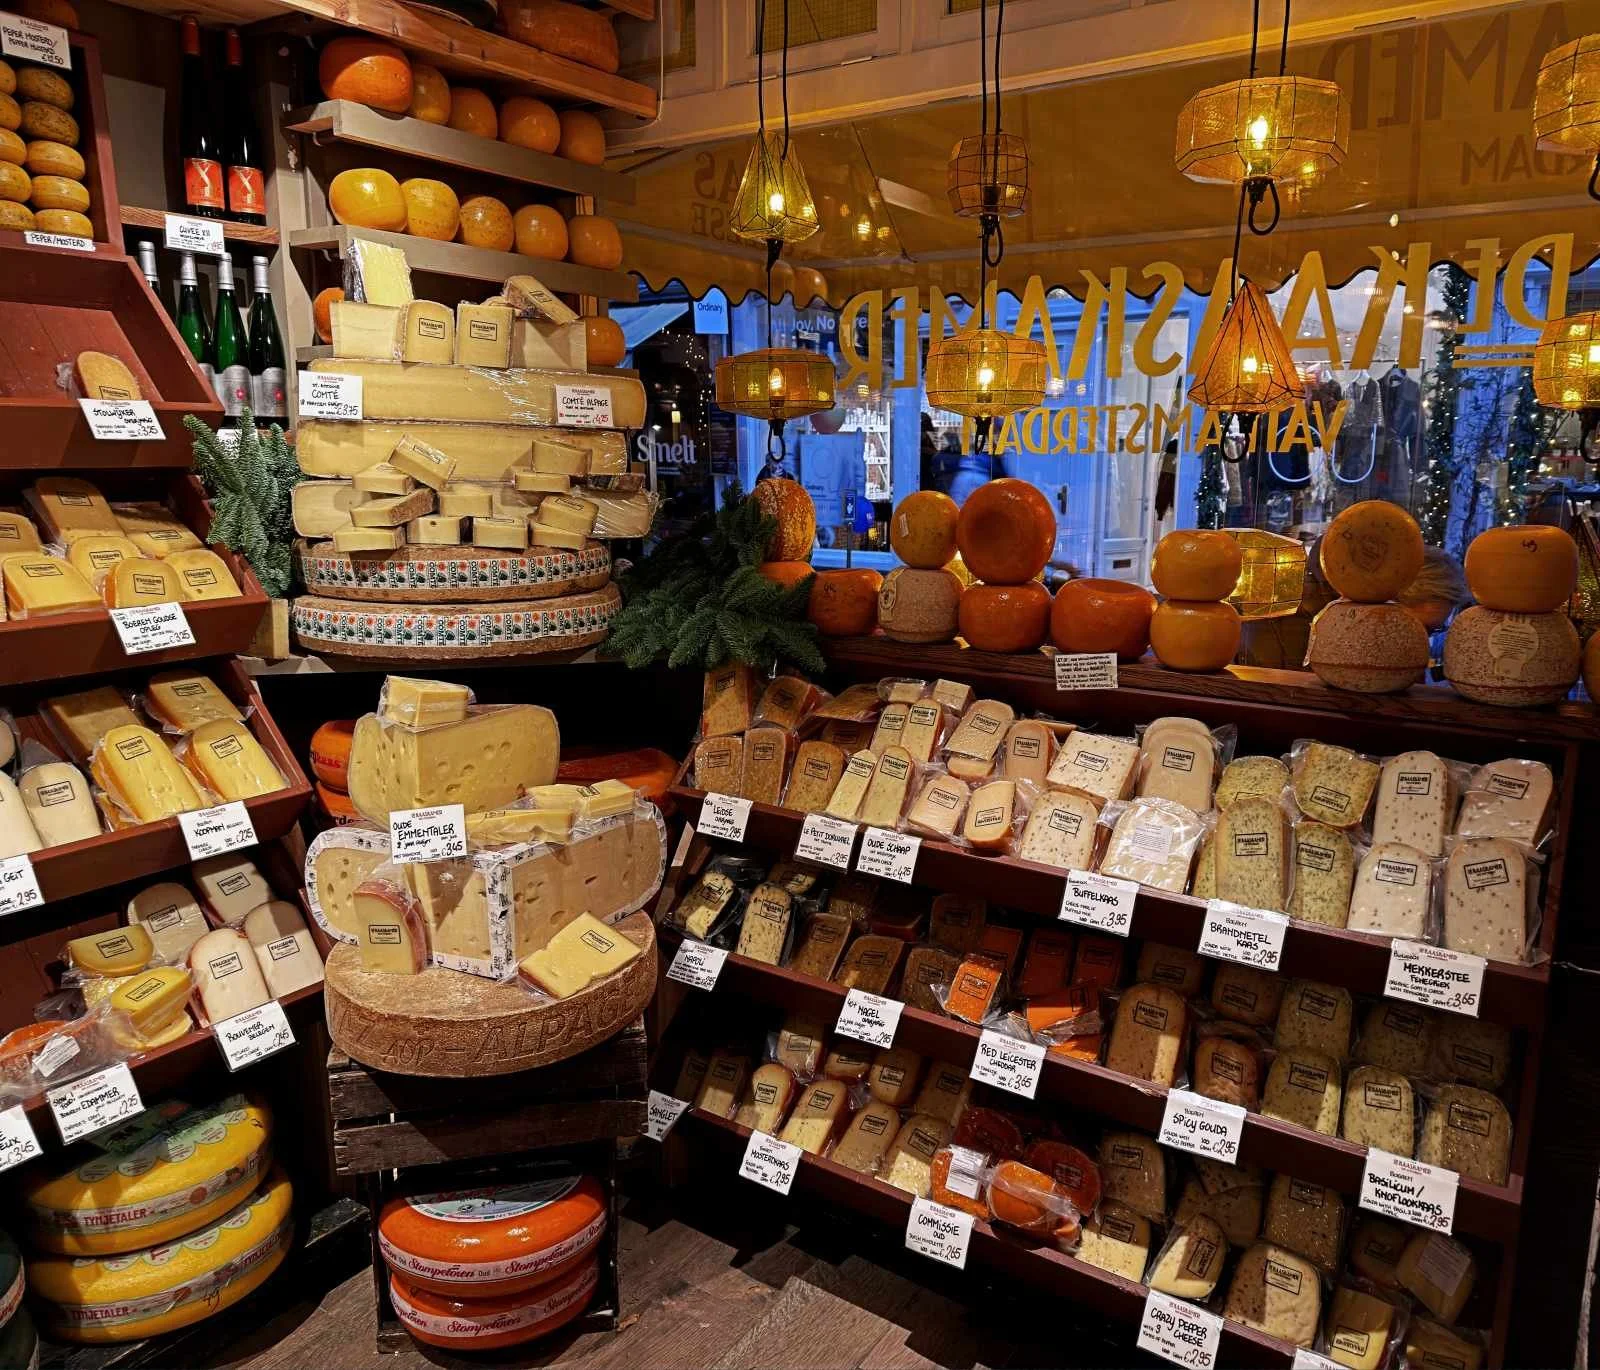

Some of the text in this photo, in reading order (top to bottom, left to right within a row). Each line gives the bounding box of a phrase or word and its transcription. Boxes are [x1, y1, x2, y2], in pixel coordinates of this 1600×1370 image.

[697, 302, 723, 315] Ordinary
[311, 390, 339, 401] COMTÉ
[562, 396, 584, 406] COMTÉ
[637, 434, 698, 465] Smelt
[193, 824, 225, 838] KOOPMAN
[392, 819, 413, 832] OUDE
[397, 822, 456, 842] EMMENTALER
[811, 826, 825, 840] PETIT
[867, 838, 885, 851] OUDE
[886, 840, 911, 855] SCHAAP
[3, 868, 24, 884] GEIT
[1072, 887, 1119, 907] BUFFELKAAS
[1209, 921, 1272, 947] BRANDNETEL
[1236, 938, 1260, 953] KAAS
[1402, 961, 1472, 985] MEKKERSTEE
[1445, 991, 1478, 1011] €3.65
[857, 1004, 880, 1020] NAGEL
[980, 1042, 998, 1059] RED
[999, 1049, 1037, 1071] LEICESTER
[989, 1057, 1017, 1074] CHEDDAR
[80, 1085, 121, 1112] EDAMMER
[1172, 1112, 1228, 1138] SPICY GOUDA
[1367, 1170, 1416, 1196] BASILICUM
[1374, 1187, 1444, 1216] KNOFLOOKKAAS
[917, 1212, 960, 1238] COMMISSIE
[933, 1230, 946, 1241] OUD
[1150, 1306, 1209, 1341] CRAZY PEPPER
[1172, 1328, 1205, 1349] CHEESE
